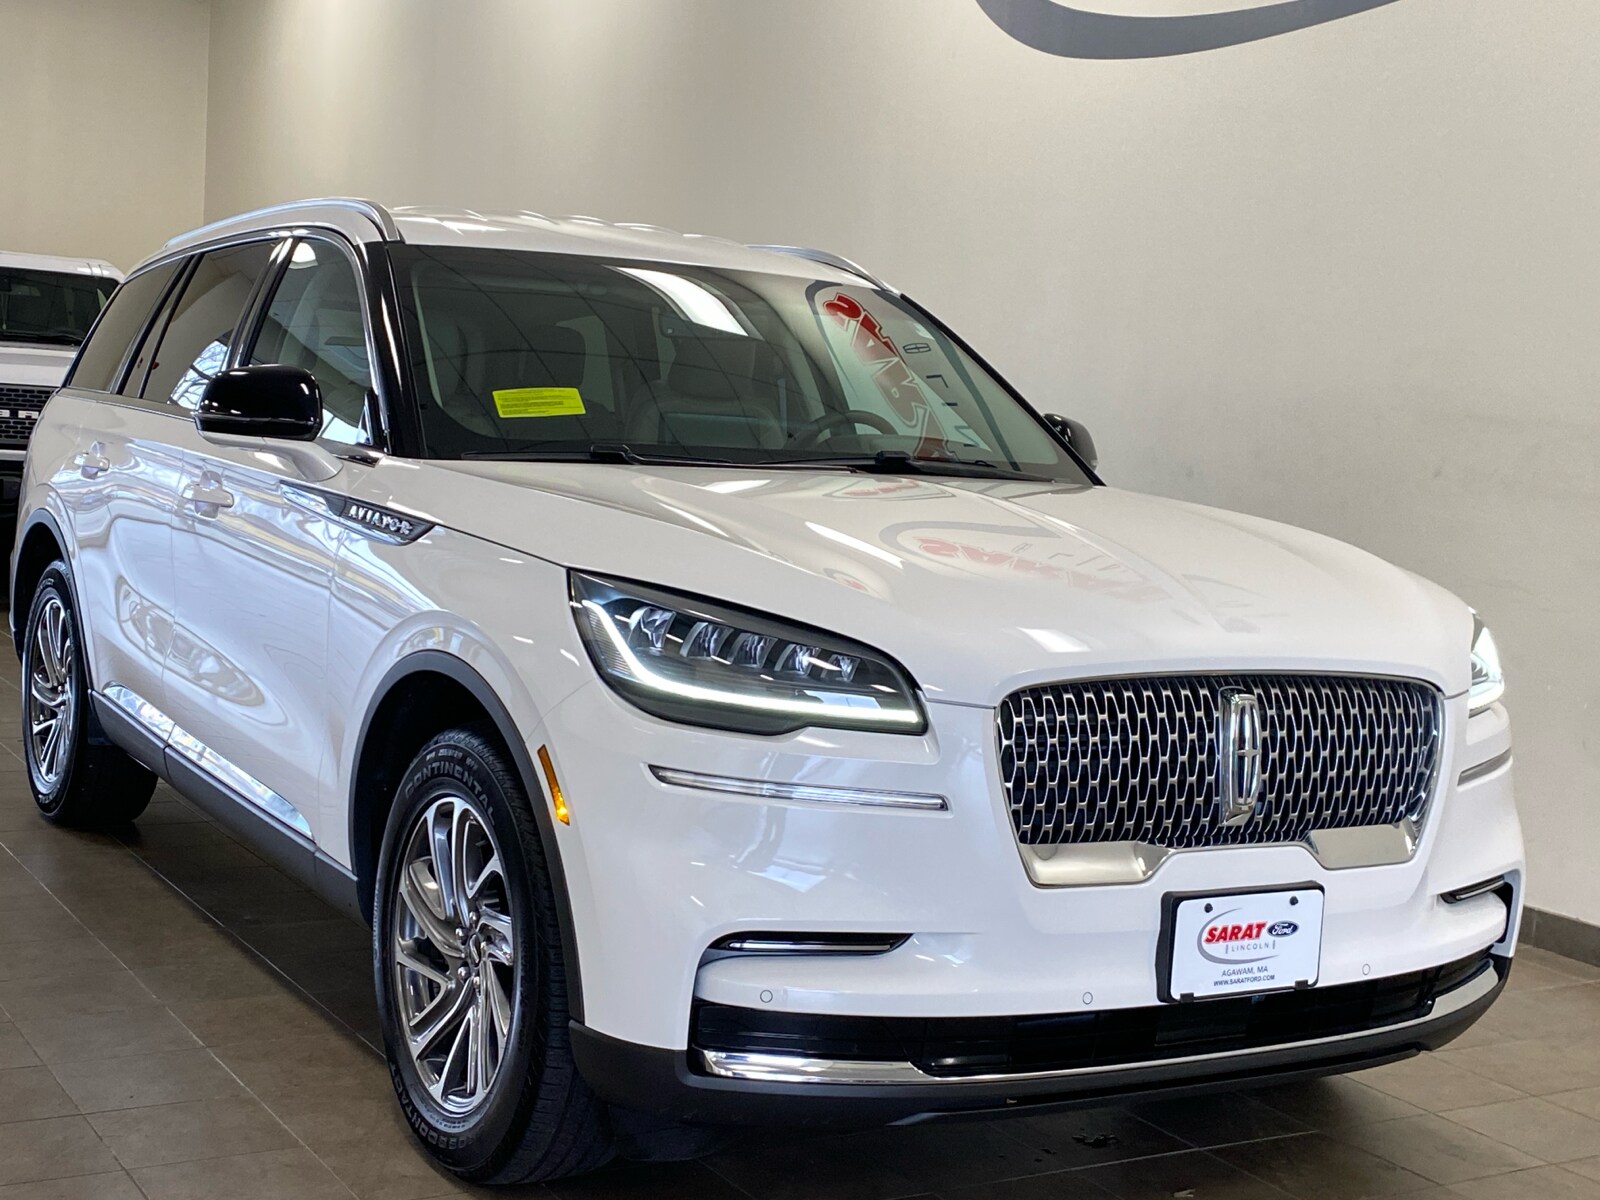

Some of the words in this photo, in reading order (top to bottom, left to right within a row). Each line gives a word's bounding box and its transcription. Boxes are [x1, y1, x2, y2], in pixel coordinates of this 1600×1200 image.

[348, 505, 413, 535] AVIATOR
[405, 761, 495, 826] CONTINENTAL
[1204, 922, 1267, 944] SARAT
[1271, 922, 1294, 936] Ford
[1231, 943, 1270, 952] LINCOLN
[1221, 967, 1255, 977] AGAWAM,
[1257, 966, 1269, 974] MA
[1213, 975, 1275, 986] WWW.SARATFORD.COM
